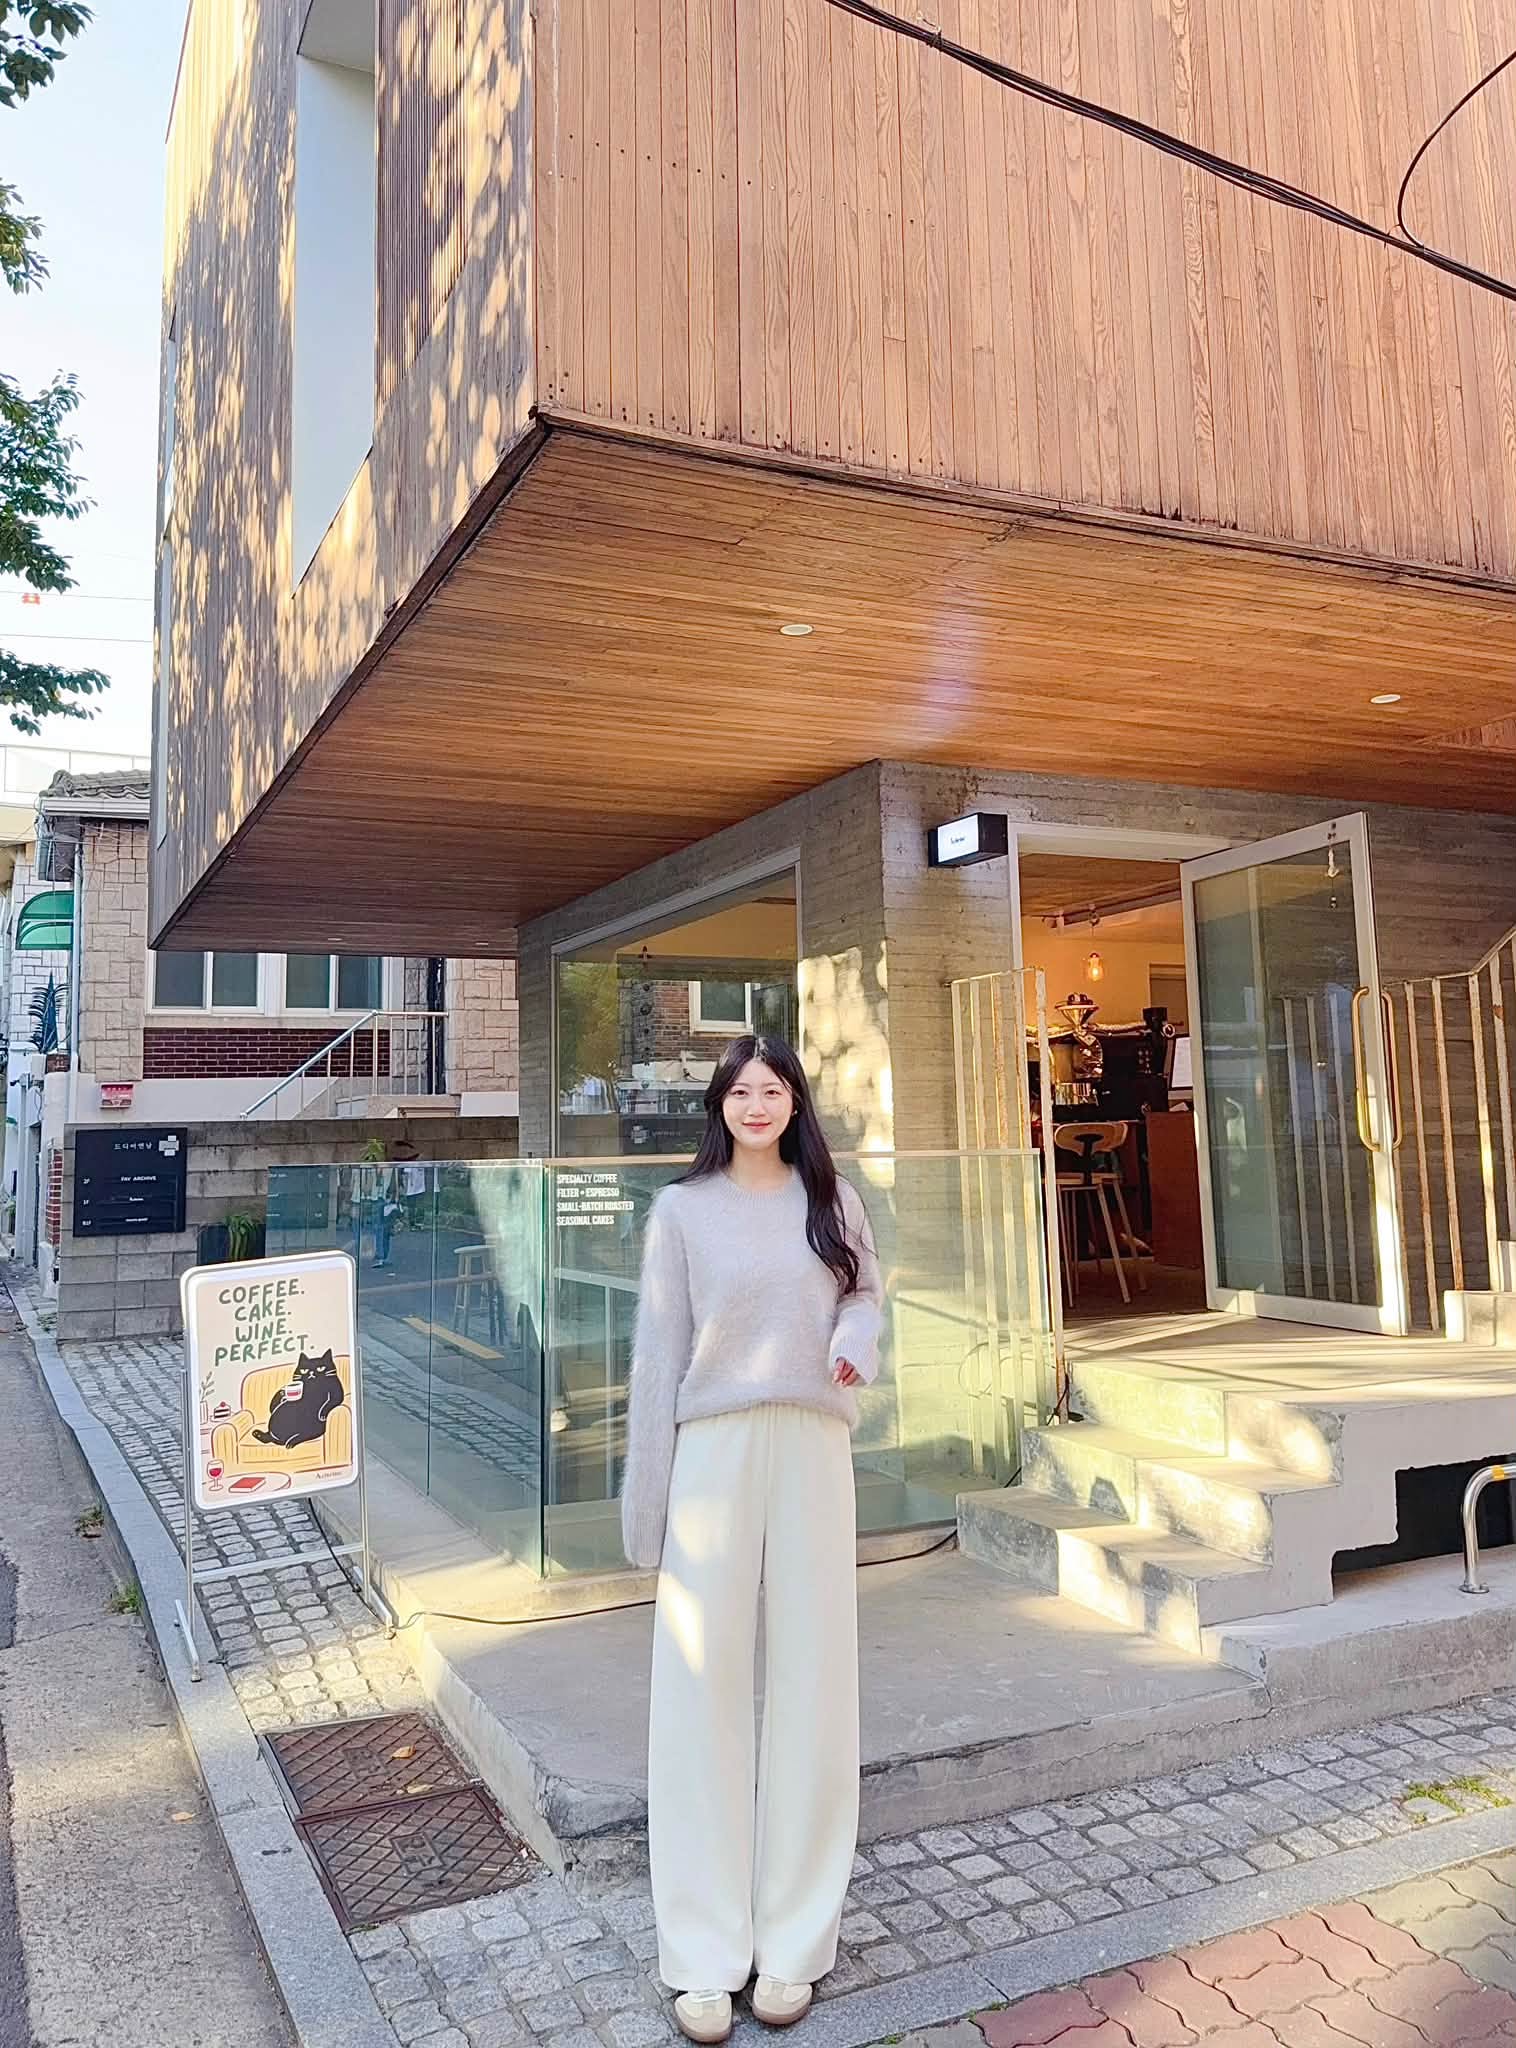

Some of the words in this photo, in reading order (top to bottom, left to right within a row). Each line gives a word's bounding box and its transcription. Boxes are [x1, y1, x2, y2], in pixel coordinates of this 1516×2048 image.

[557, 1174, 592, 1183] SPECIALTY
[593, 1174, 618, 1183] COFFEE
[557, 1188, 579, 1197] FILTER
[586, 1188, 620, 1197] ESPRESSO
[557, 1201, 604, 1211] SMALL-BATCH
[605, 1201, 634, 1211] ROASTED
[557, 1215, 591, 1225] SEASONAL
[592, 1215, 615, 1225] CAKES
[219, 1279, 304, 1304] COFFEE.
[234, 1299, 292, 1322] CAKE.
[235, 1318, 293, 1342] WINE.
[215, 1334, 314, 1366] PERFECT.
